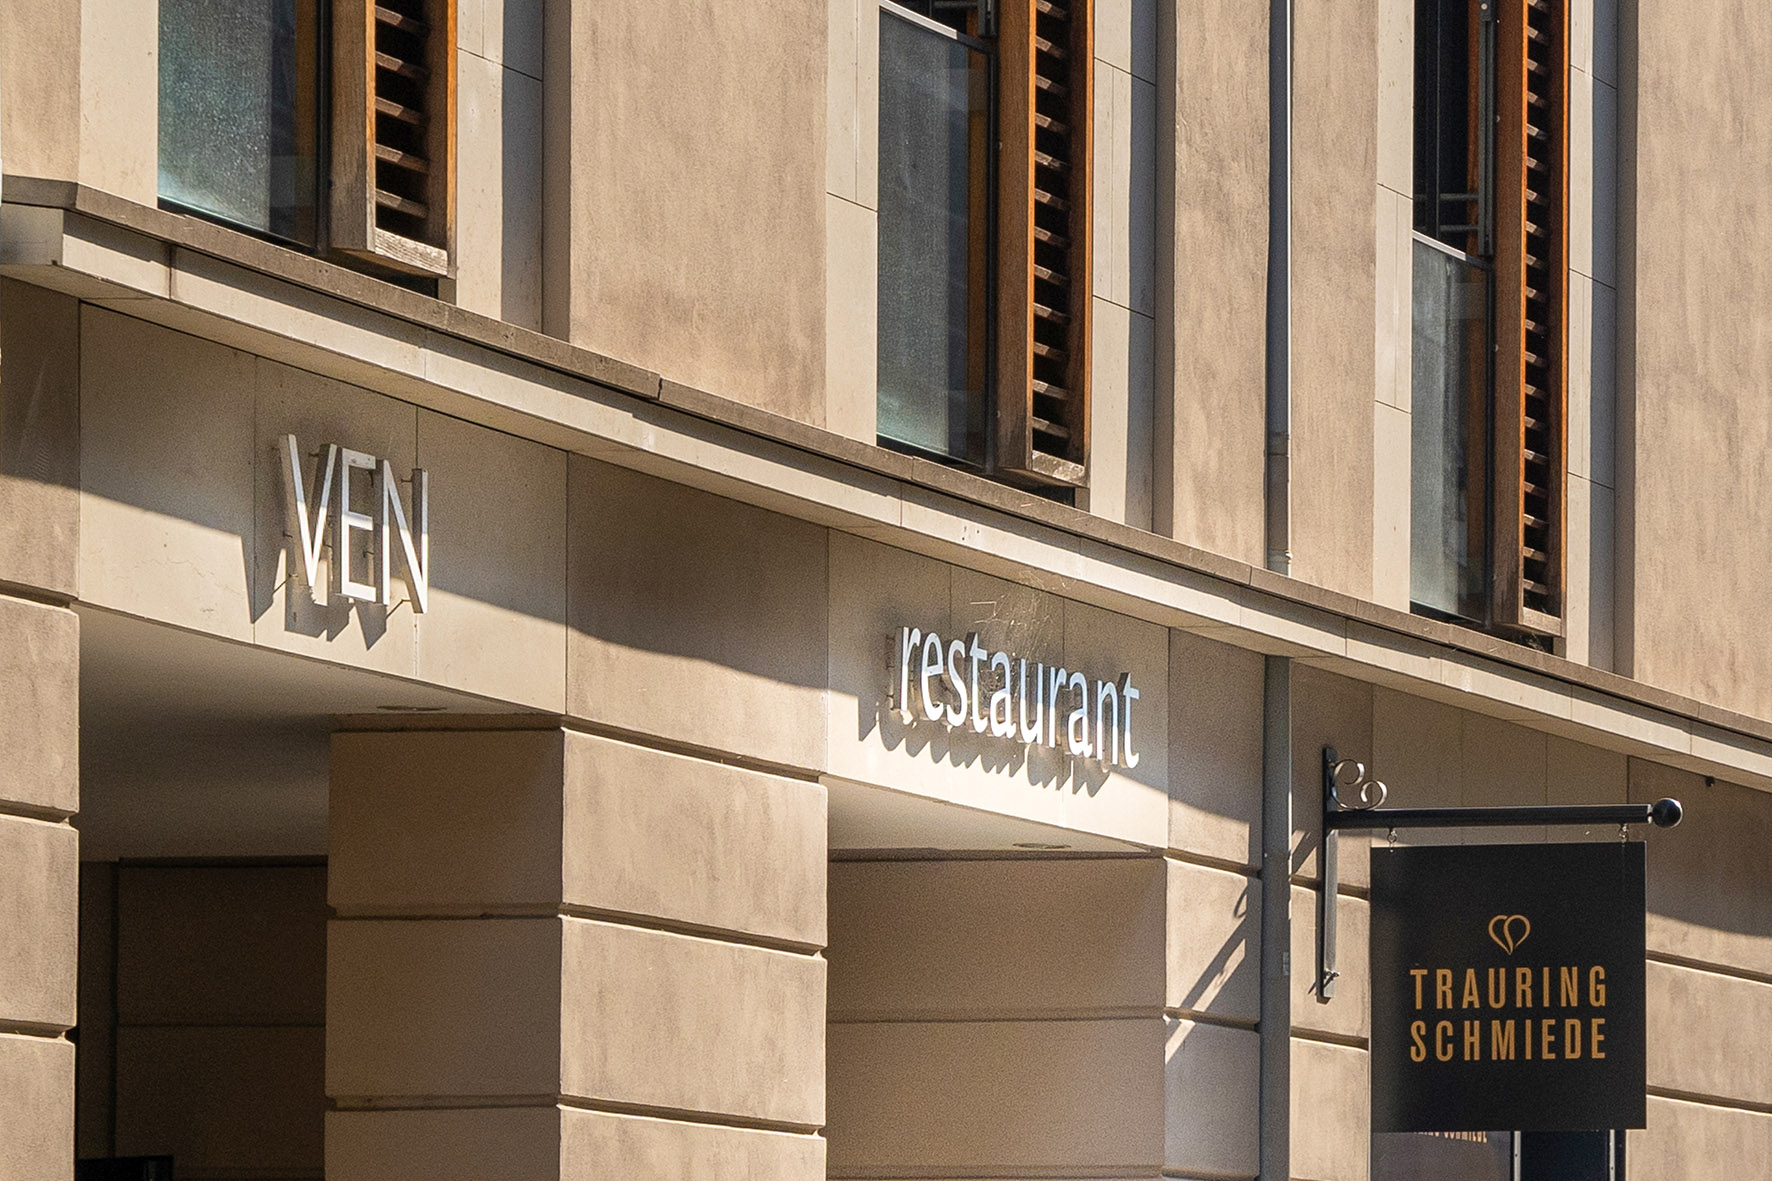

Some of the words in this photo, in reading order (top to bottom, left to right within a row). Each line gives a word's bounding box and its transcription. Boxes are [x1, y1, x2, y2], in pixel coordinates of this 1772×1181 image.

[280, 433, 428, 614] VEN
[898, 626, 1140, 768] restaurant
[1410, 965, 1606, 1010] TRAURING
[1410, 1018, 1606, 1062] SCHMIEDE
